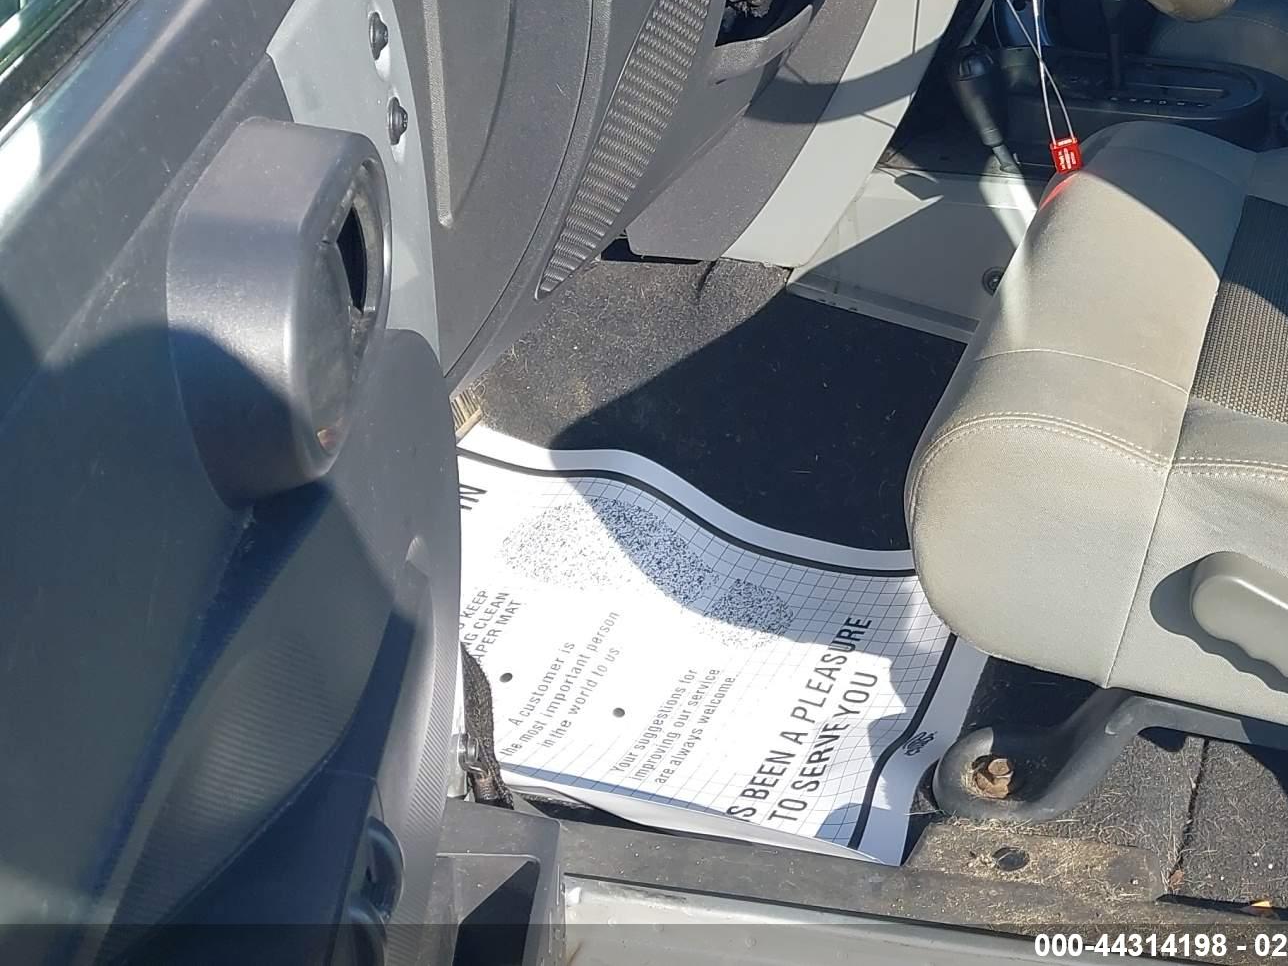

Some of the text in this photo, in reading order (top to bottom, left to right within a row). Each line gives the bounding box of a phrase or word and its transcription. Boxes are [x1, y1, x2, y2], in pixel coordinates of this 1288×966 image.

[459, 591, 488, 619] KEEP
[473, 592, 510, 630] CLEAN
[496, 599, 522, 626] MAT
[499, 611, 620, 757] the most important person
[508, 642, 576, 726] A customer is
[539, 647, 620, 748] in the world to us
[790, 617, 873, 724] PLEASURE
[610, 669, 698, 772] Your suggestions for
[629, 669, 720, 781] improving our service
[655, 768, 675, 784] are
[670, 728, 703, 766] always
[768, 671, 879, 822] TO SERVE YOU
[780, 731, 809, 745] A
[740, 750, 796, 800] BEEN
